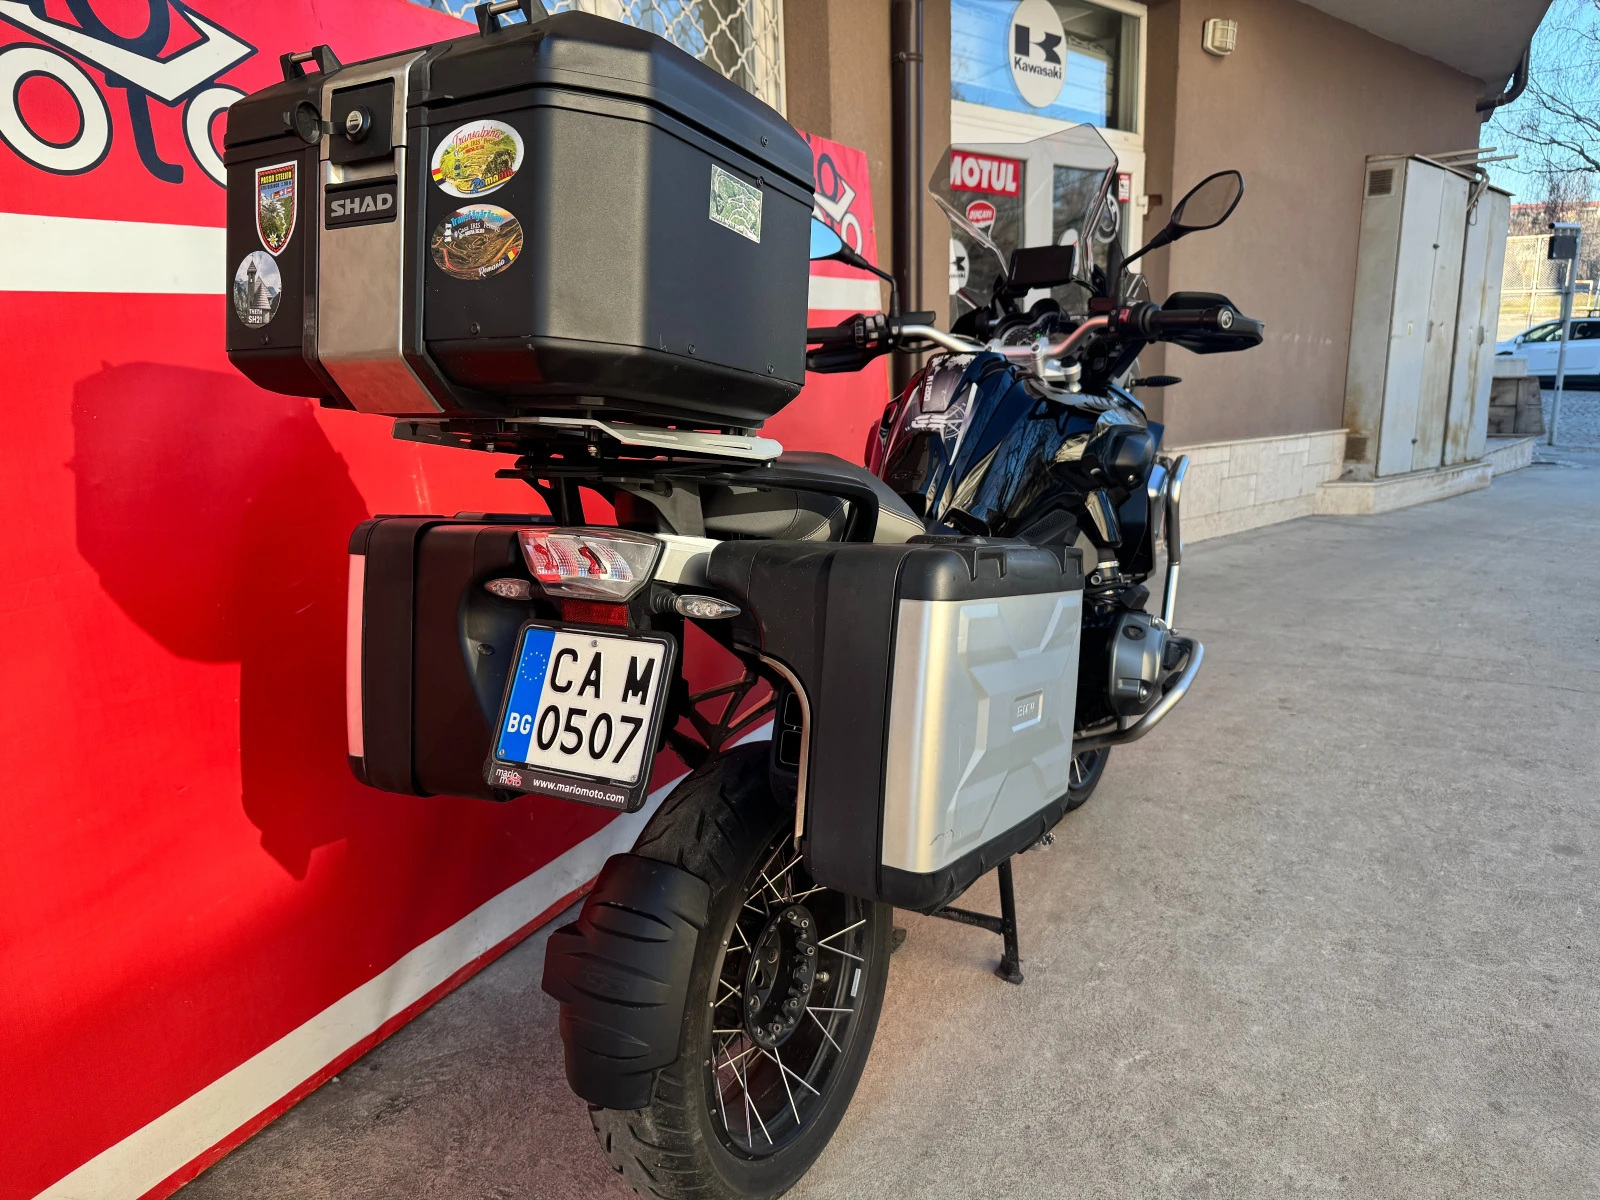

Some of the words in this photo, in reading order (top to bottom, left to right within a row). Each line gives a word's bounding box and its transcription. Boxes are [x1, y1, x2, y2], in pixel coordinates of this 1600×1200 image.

[1014, 56, 1061, 80] Kawasaki
[453, 126, 502, 148] Transalpina
[470, 168, 513, 194] Romania
[950, 155, 1017, 192] MOTUL
[331, 193, 393, 217] SHAD
[969, 209, 993, 220] DUCATI
[479, 259, 505, 277] Romania
[248, 315, 263, 324] SH21
[923, 375, 934, 402] R1200
[550, 648, 602, 698] CA
[621, 655, 655, 706] M
[507, 712, 532, 735] BG
[537, 705, 643, 763] 0507
[496, 768, 519, 778] mario
[499, 774, 522, 787] moto
[533, 778, 625, 804] www.mariomoto.com
